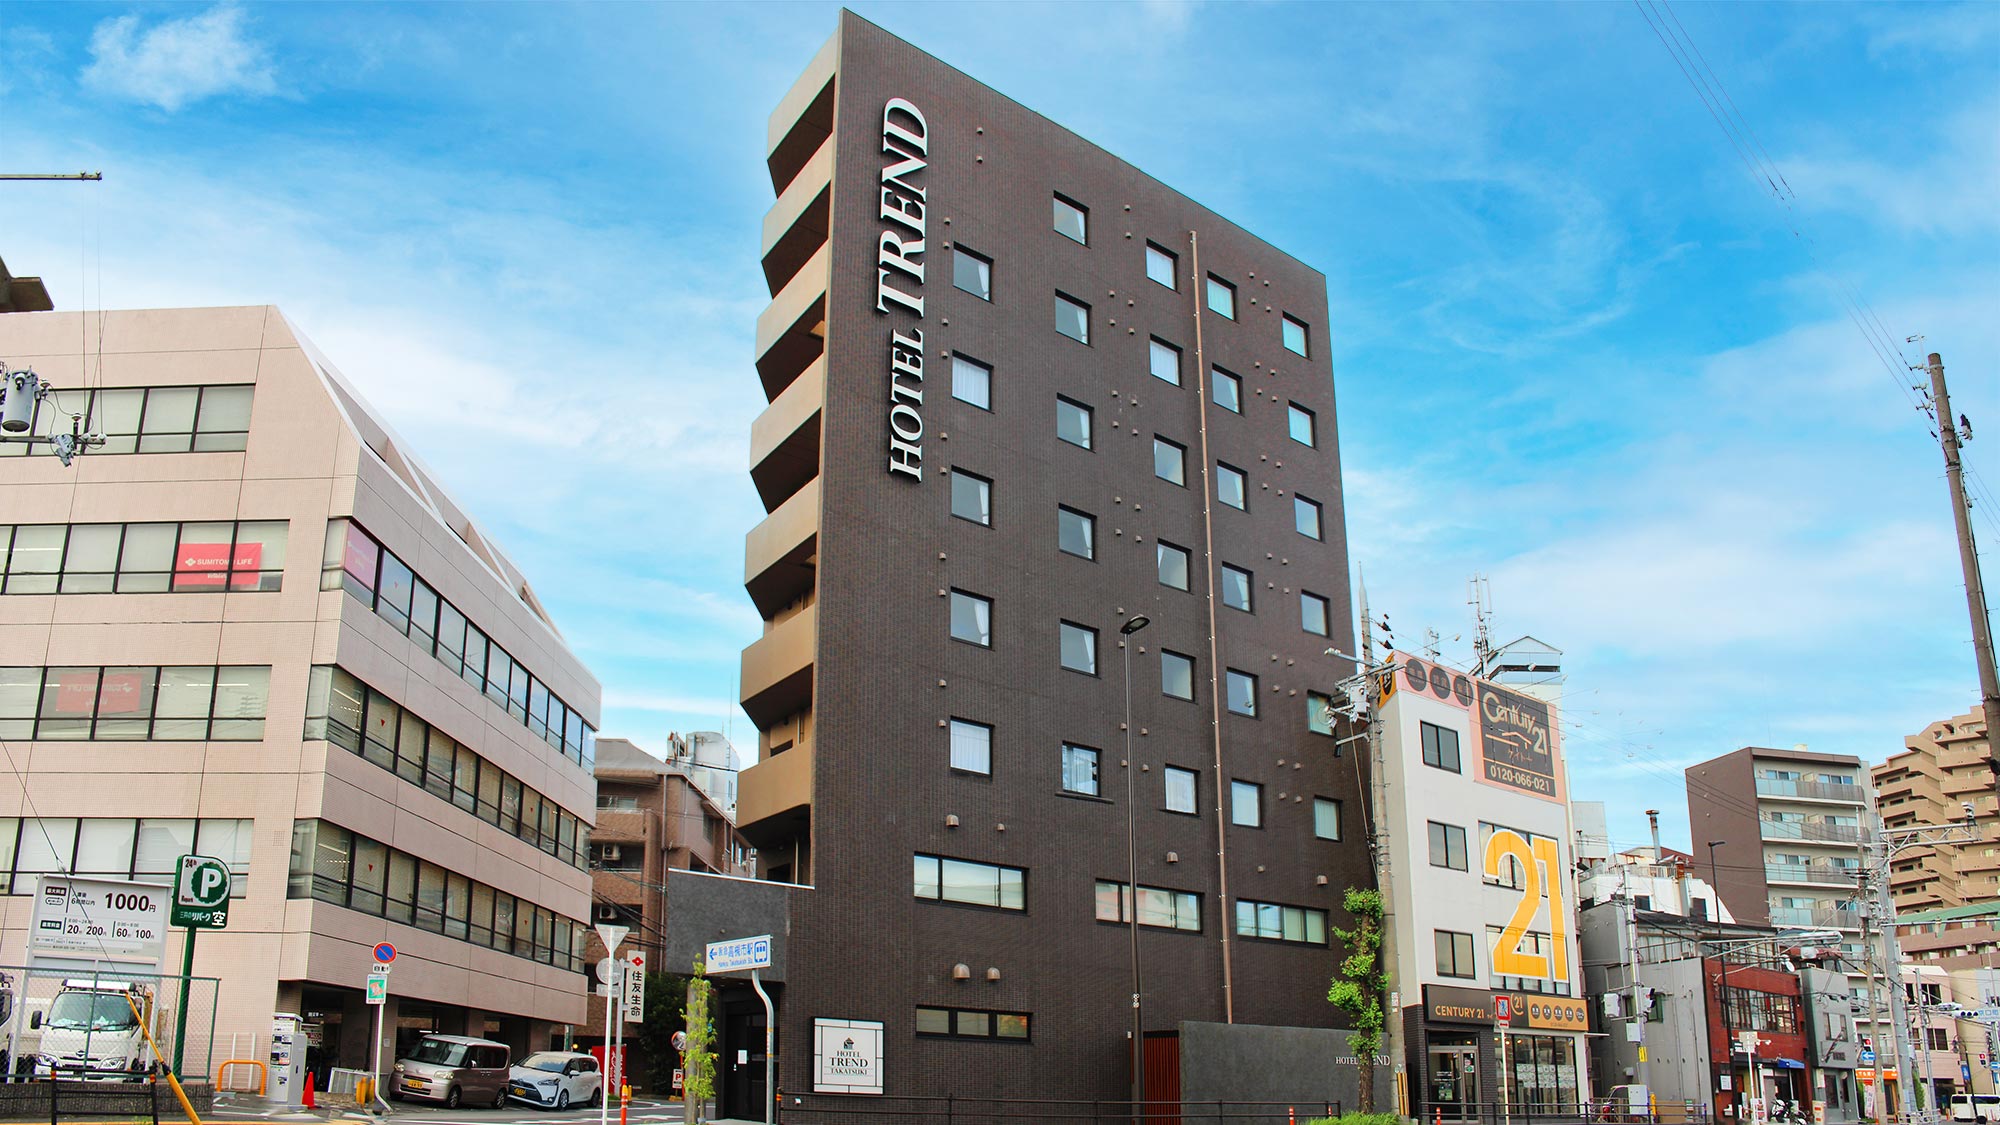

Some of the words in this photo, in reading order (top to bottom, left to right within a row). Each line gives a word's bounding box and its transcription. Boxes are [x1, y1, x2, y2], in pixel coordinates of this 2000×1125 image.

[876, 97, 928, 318] TREND
[890, 328, 923, 481] HOTEL
[237, 558, 253, 566] LIFE
[1532, 726, 1549, 756] 21
[1490, 765, 1551, 793] 0120-066-021
[200, 867, 222, 898] P
[1484, 828, 1569, 983] 21
[212, 910, 226, 926] 空
[630, 970, 642, 1017] 住友生命
[1435, 1005, 1476, 1018] CENTURY
[1477, 1008, 1485, 1019] 21
[829, 1057, 868, 1068] TREND
[836, 1050, 861, 1058] HOTEL
[1335, 1056, 1358, 1065] HOTEL
[830, 1067, 868, 1076] TAKATSUKI
